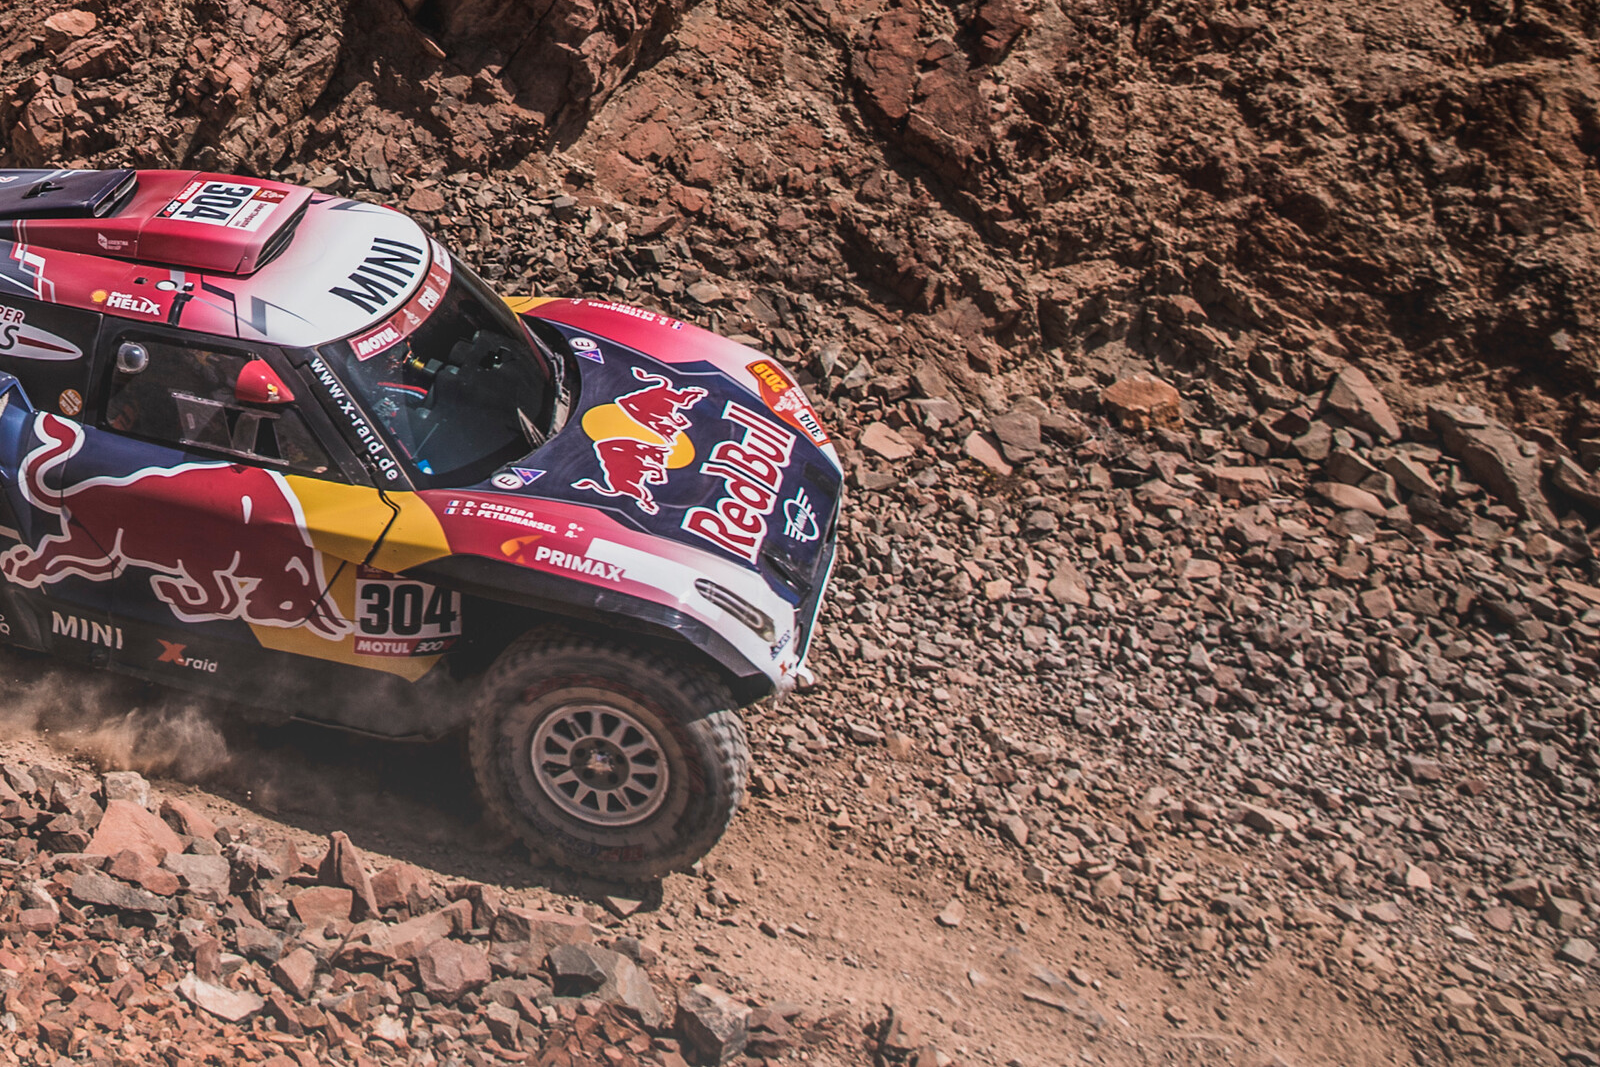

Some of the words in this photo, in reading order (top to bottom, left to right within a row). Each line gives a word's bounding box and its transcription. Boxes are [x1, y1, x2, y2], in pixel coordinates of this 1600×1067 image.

[179, 184, 253, 221] 304
[328, 237, 423, 315] MINI
[106, 295, 161, 315] HELIX
[357, 326, 399, 356] MOTUL
[752, 362, 789, 393] 2019
[310, 357, 399, 481] www.x-raid.de
[799, 413, 823, 438] 304
[462, 508, 473, 516] S.
[476, 510, 557, 534] PETERHANSEL
[465, 500, 477, 509] D.
[480, 502, 535, 519] CASTERA
[534, 545, 626, 582] PRIMAX
[360, 583, 457, 636] 304
[52, 611, 123, 650] MINI
[357, 640, 409, 654] MOTUL
[157, 638, 219, 673] X-raid
